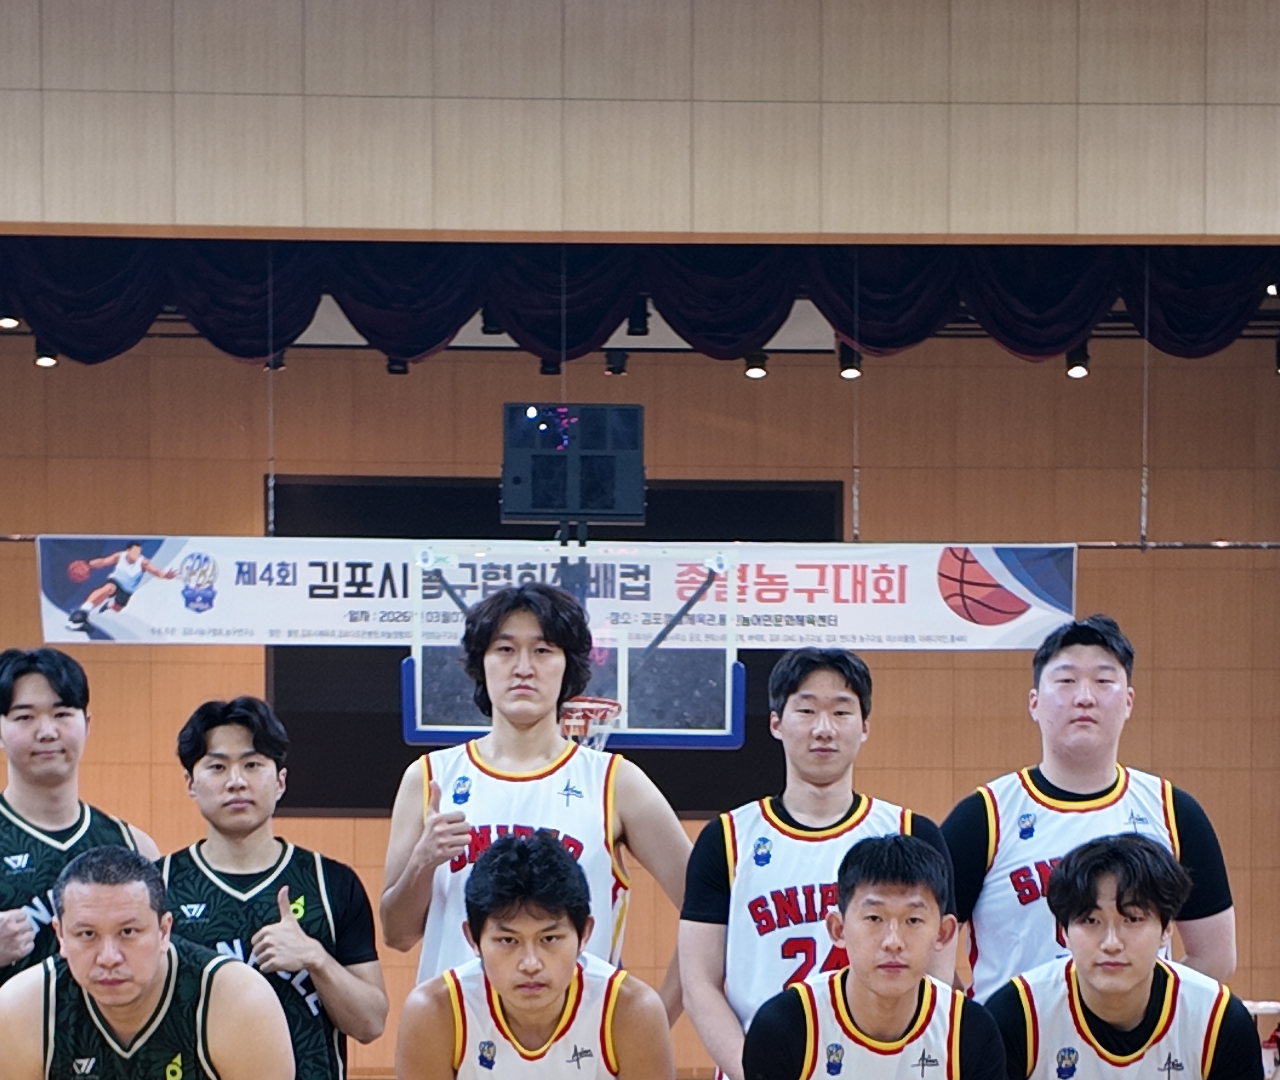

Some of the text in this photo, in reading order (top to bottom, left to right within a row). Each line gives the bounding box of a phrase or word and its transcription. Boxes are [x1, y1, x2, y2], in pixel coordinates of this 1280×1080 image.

[235, 562, 297, 586] 제4회
[308, 561, 409, 599] 김포시
[748, 883, 838, 936] SNIP
